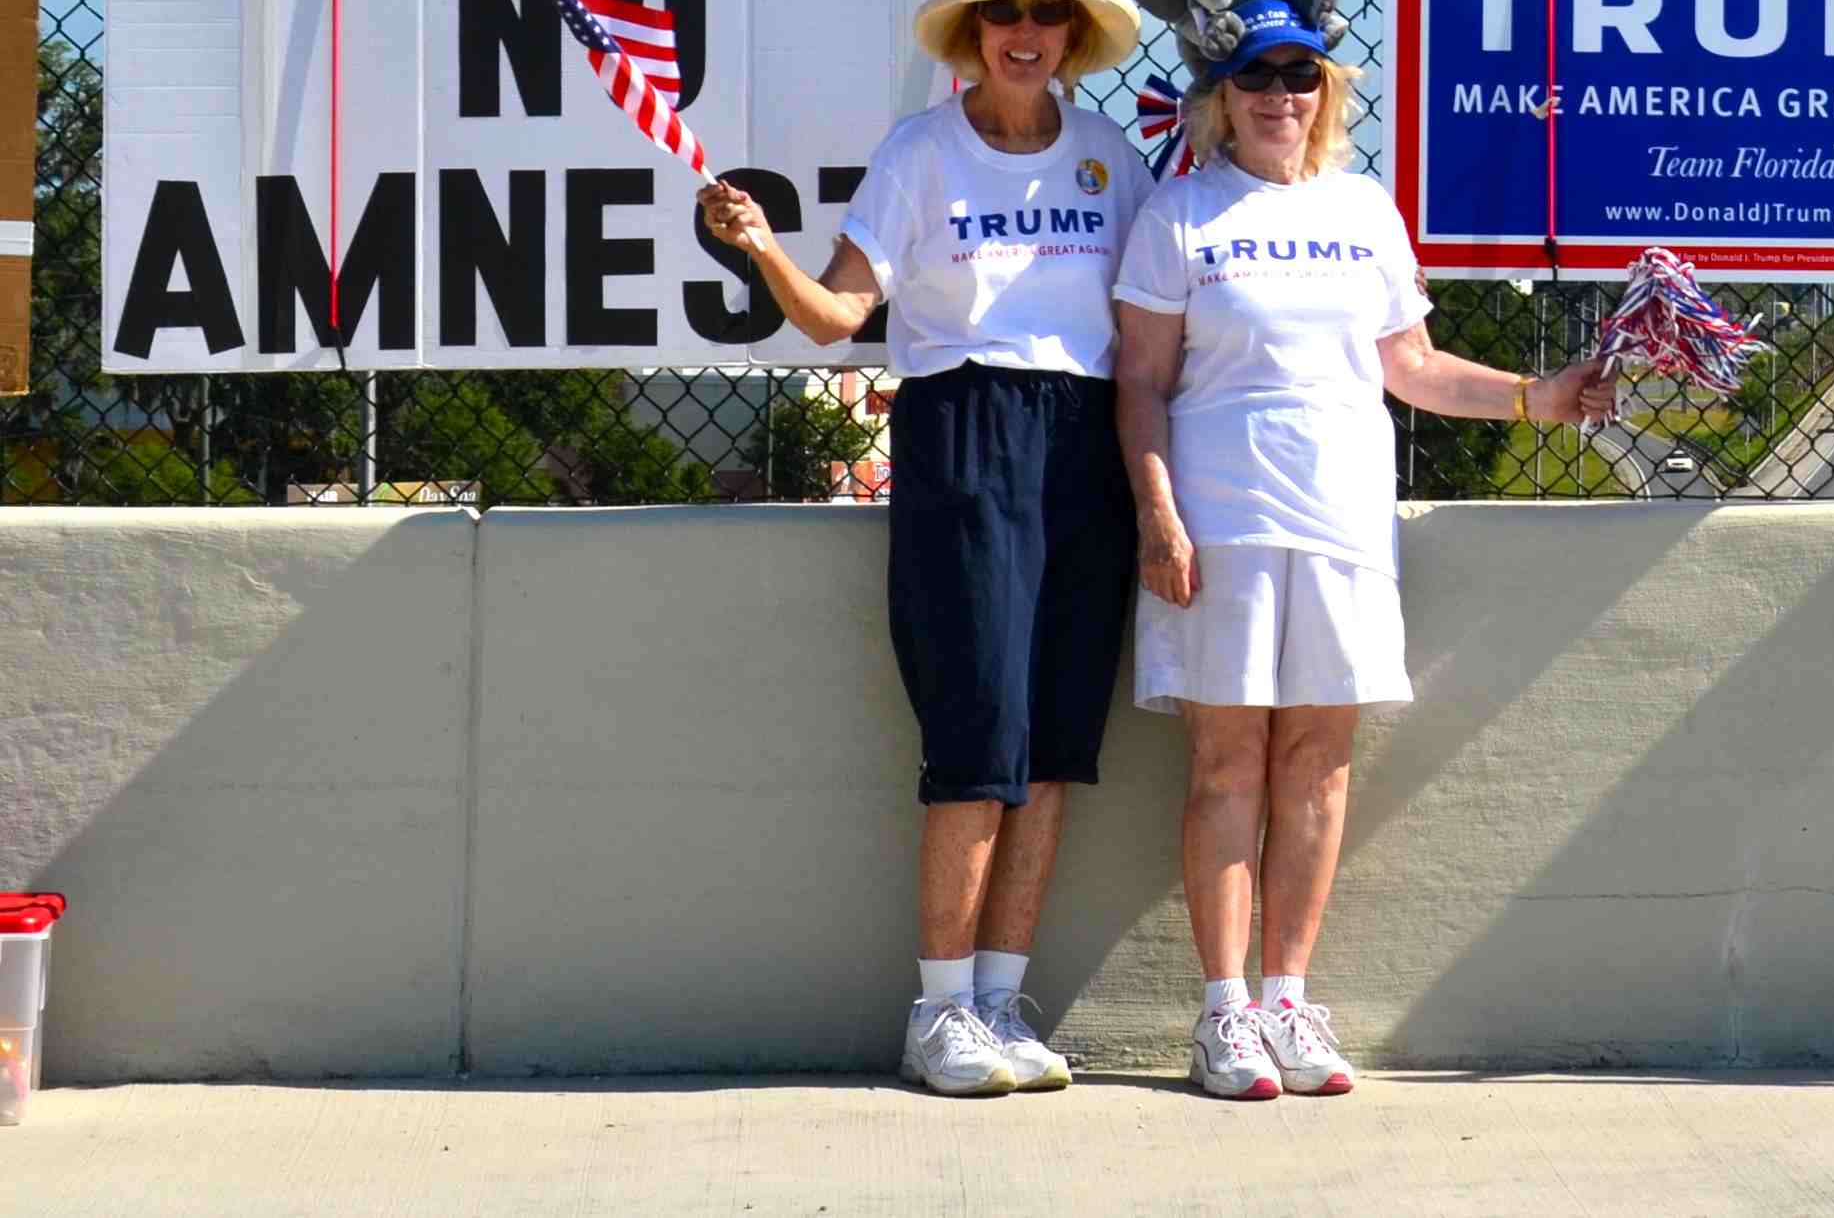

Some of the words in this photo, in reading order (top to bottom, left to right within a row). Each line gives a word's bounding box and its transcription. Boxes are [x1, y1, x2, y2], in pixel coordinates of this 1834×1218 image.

[1453, 84, 1564, 114] MAKE
[1578, 85, 1762, 117] AMERICA
[1647, 145, 1723, 177] Team
[948, 209, 1104, 240] TRUMP
[1039, 244, 1075, 256] GREAT
[1195, 238, 1374, 265] TRUMP
